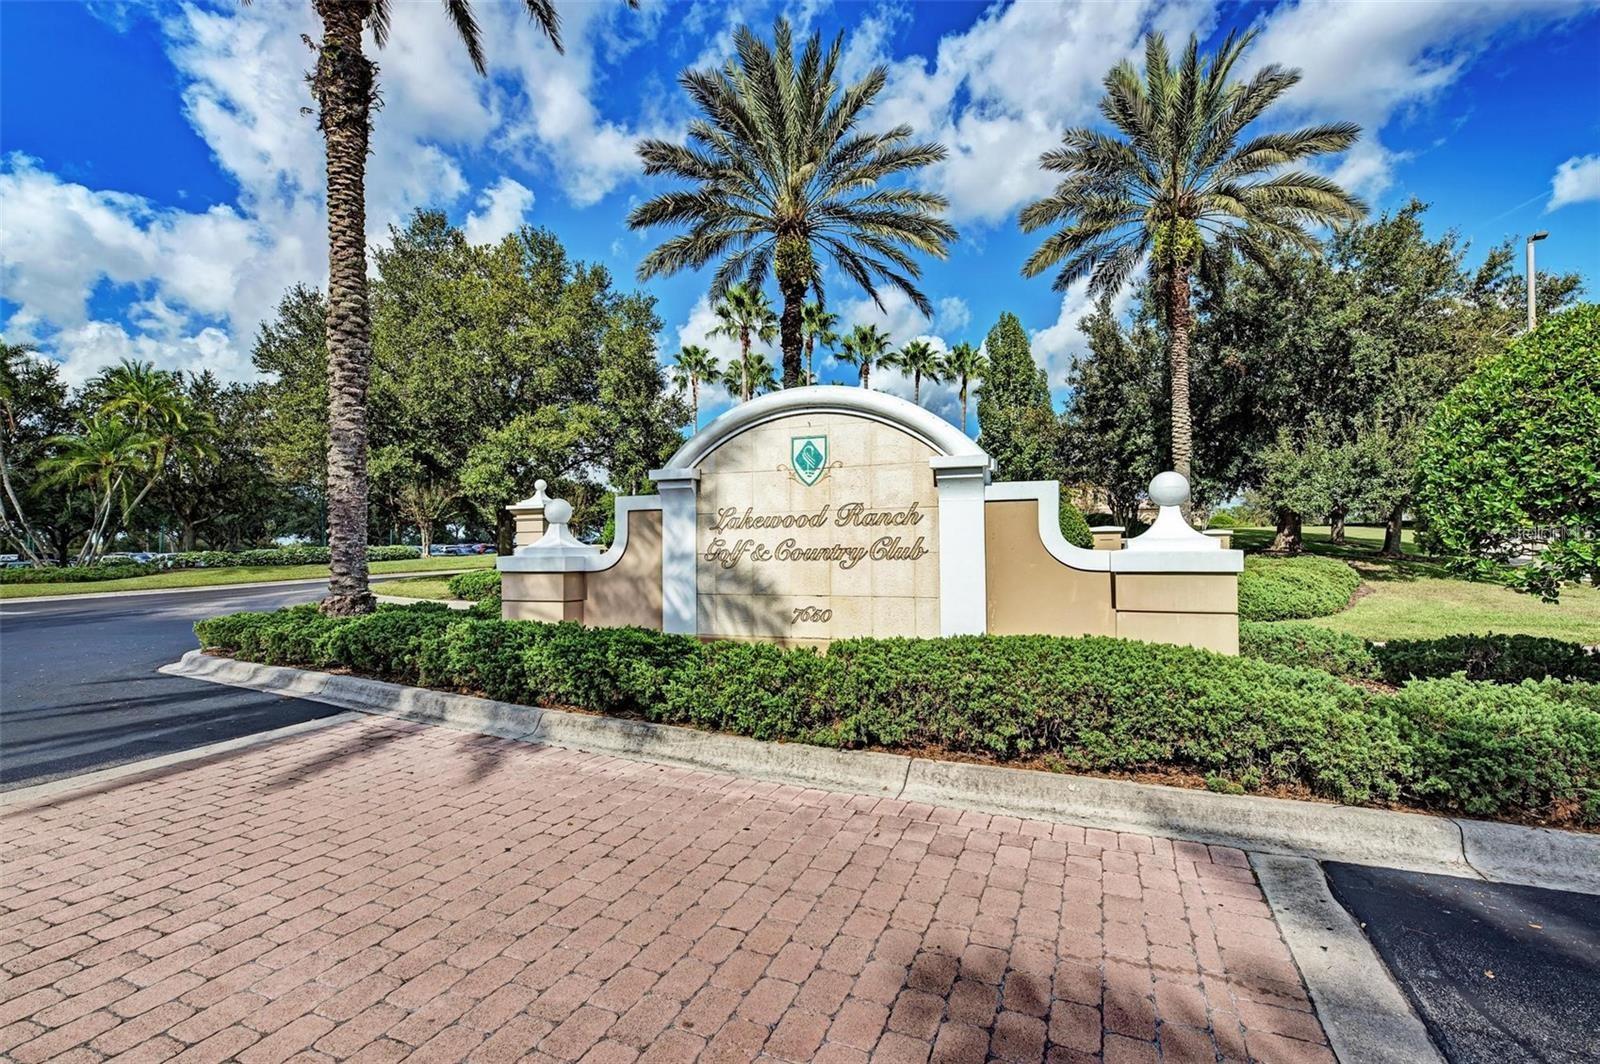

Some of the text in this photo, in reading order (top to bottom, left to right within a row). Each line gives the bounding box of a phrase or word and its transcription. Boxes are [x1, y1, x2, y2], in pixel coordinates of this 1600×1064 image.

[709, 502, 924, 534] Lakewood Ranch
[704, 536, 929, 570] Golf & Country Club
[791, 605, 833, 625] 7650
